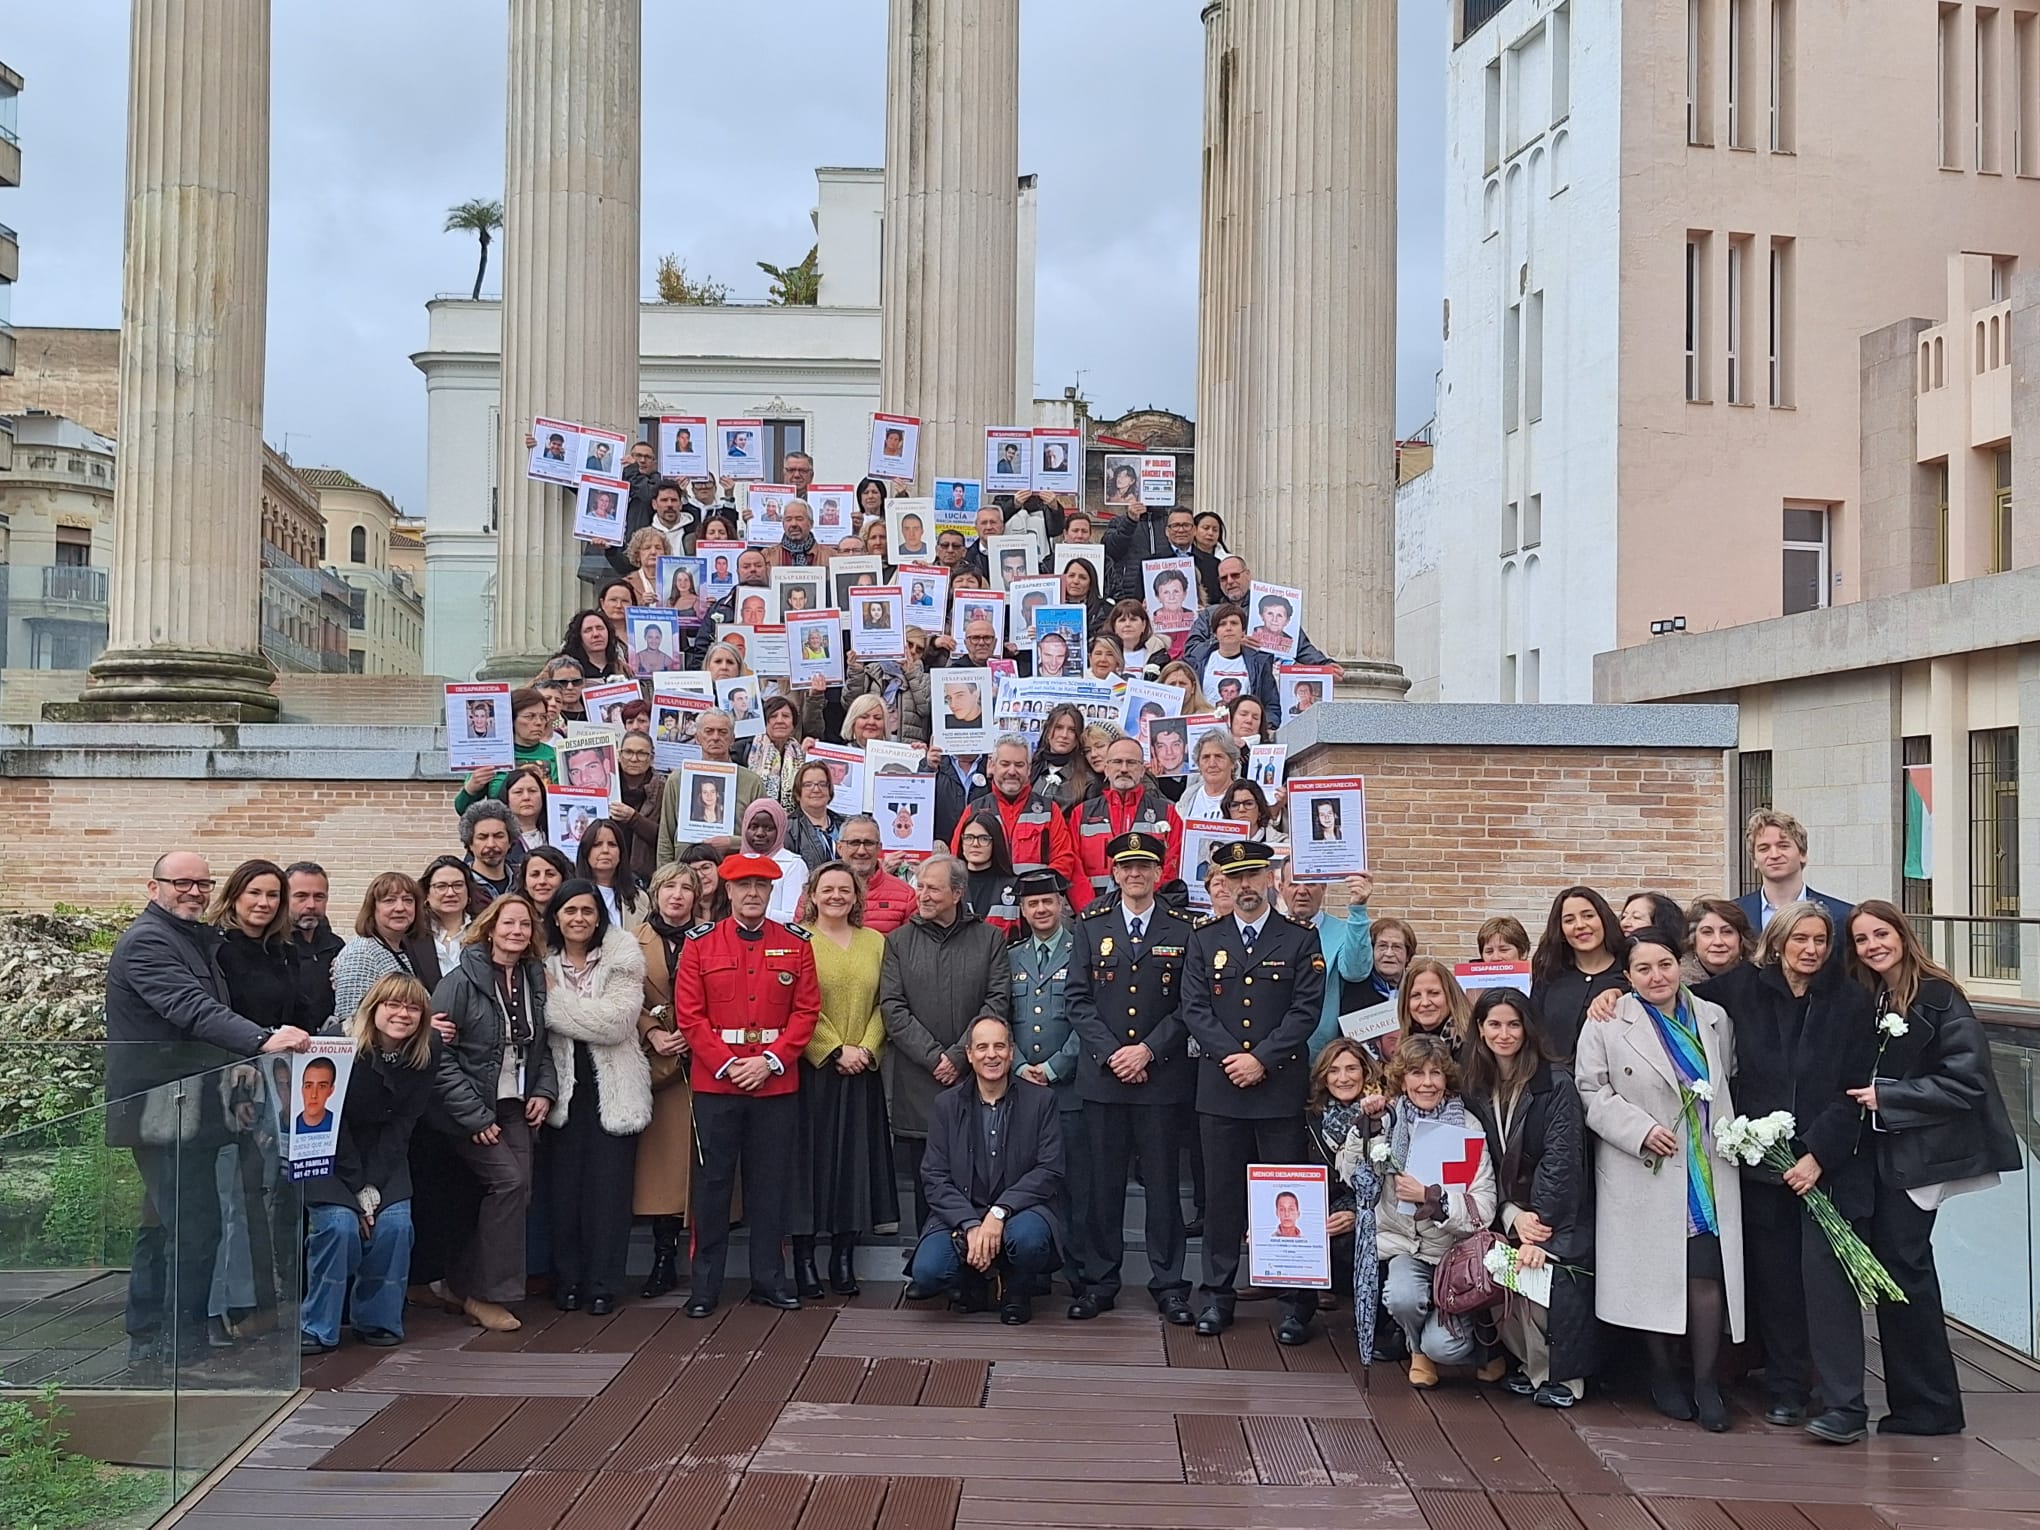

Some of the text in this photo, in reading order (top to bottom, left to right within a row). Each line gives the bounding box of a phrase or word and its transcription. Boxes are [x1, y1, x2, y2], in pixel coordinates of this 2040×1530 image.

[944, 512, 968, 520] LUCÍA
[1130, 687, 1181, 701] DESAPARECIDO
[565, 736, 610, 749] DESAPARECIDO
[1193, 824, 1240, 832] DESAPARECIDO
[305, 1158, 329, 1168] FAMILIA
